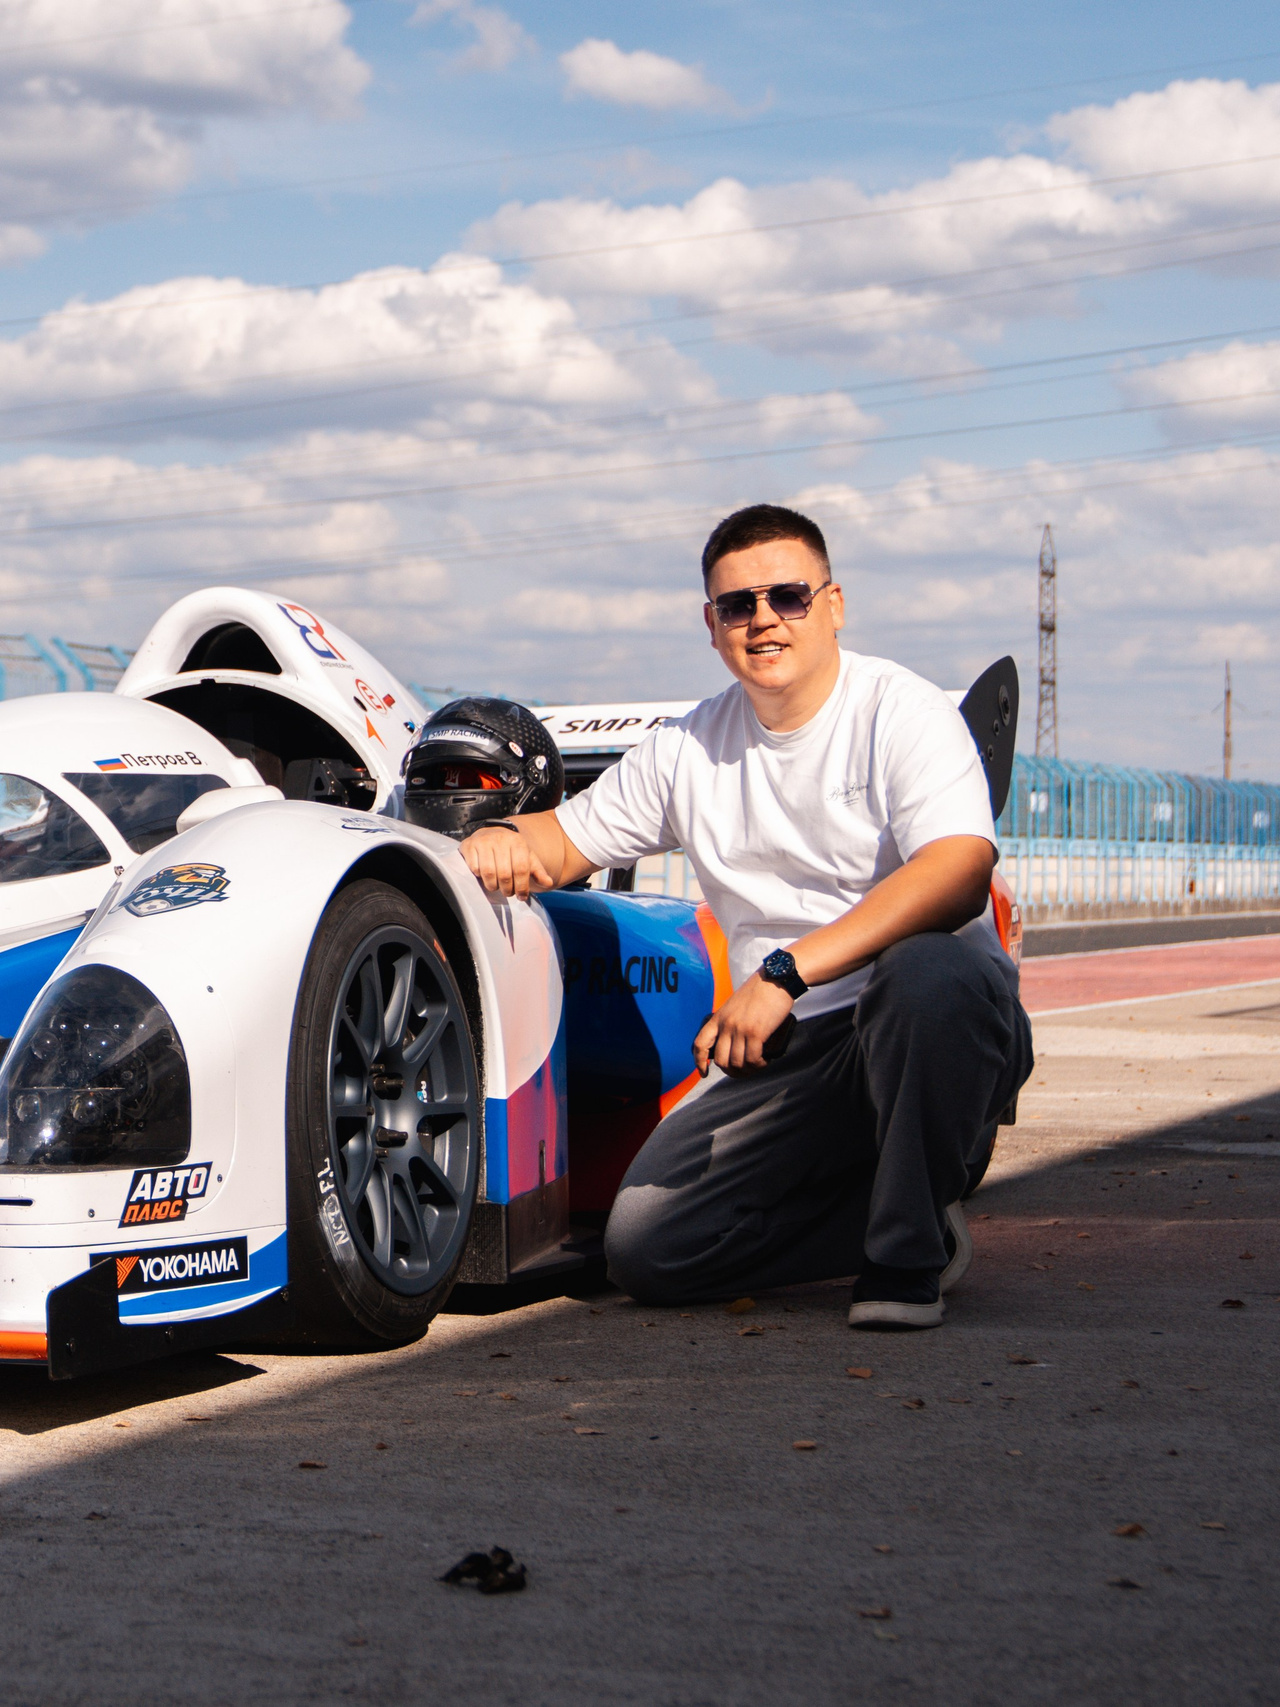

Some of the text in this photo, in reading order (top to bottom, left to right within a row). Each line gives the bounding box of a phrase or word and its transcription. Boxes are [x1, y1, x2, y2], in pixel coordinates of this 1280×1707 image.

[431, 729, 449, 739] SMP
[450, 728, 487, 740] RACING
[558, 717, 642, 734] SMP
[121, 753, 188, 769] Петров
[588, 956, 679, 995] RACING
[129, 1167, 208, 1202] АВТО
[123, 1200, 183, 1223] ПЛЮС
[138, 1248, 239, 1283] YOKOHAMA
